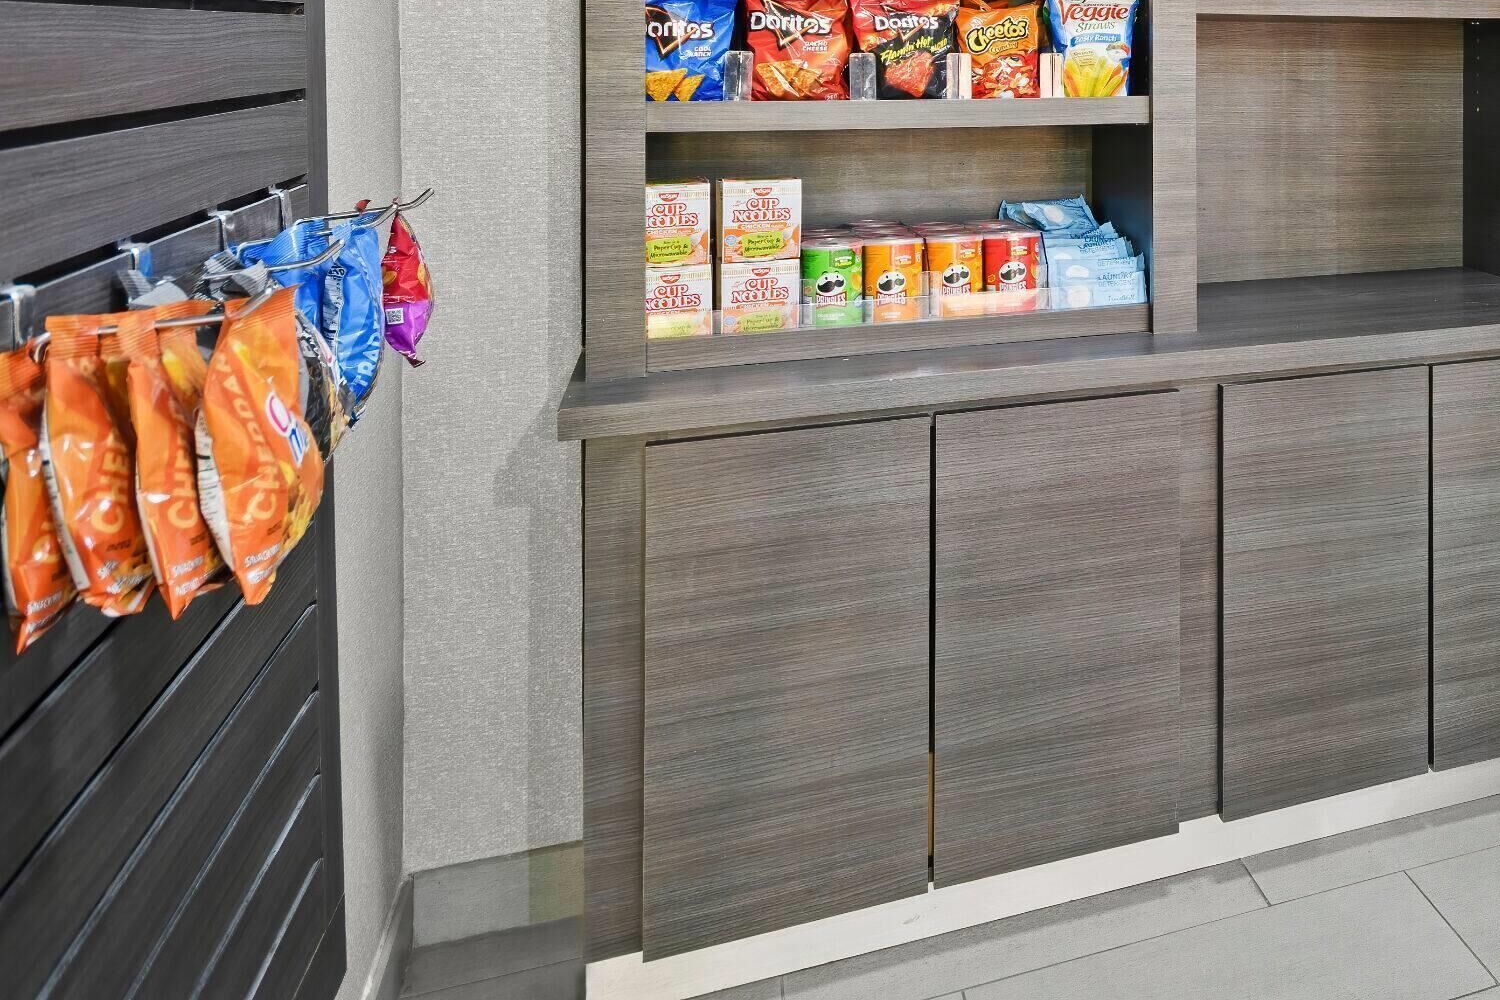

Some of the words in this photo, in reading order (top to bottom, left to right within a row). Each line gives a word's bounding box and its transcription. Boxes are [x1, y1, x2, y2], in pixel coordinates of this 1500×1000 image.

[750, 11, 833, 34] Doritos
[874, 14, 939, 32] Doritos
[1074, 21, 1117, 34] Straws
[646, 20, 715, 40] oritos
[966, 16, 1029, 54] Cheetos
[915, 36, 934, 49] Hot
[1095, 34, 1118, 43] Ranch
[990, 41, 1020, 55] Crunchy
[651, 202, 687, 216] CUP
[746, 197, 780, 211] CUP
[732, 207, 791, 223] NOODLES
[653, 284, 689, 298] CUP
[745, 277, 779, 291] CUP
[941, 284, 972, 297] PRINGLES
[999, 281, 1027, 294] PRINGLES
[731, 287, 790, 304] NOODLES
[815, 293, 847, 308] PRINGLES
[876, 293, 907, 306] PRINGLES
